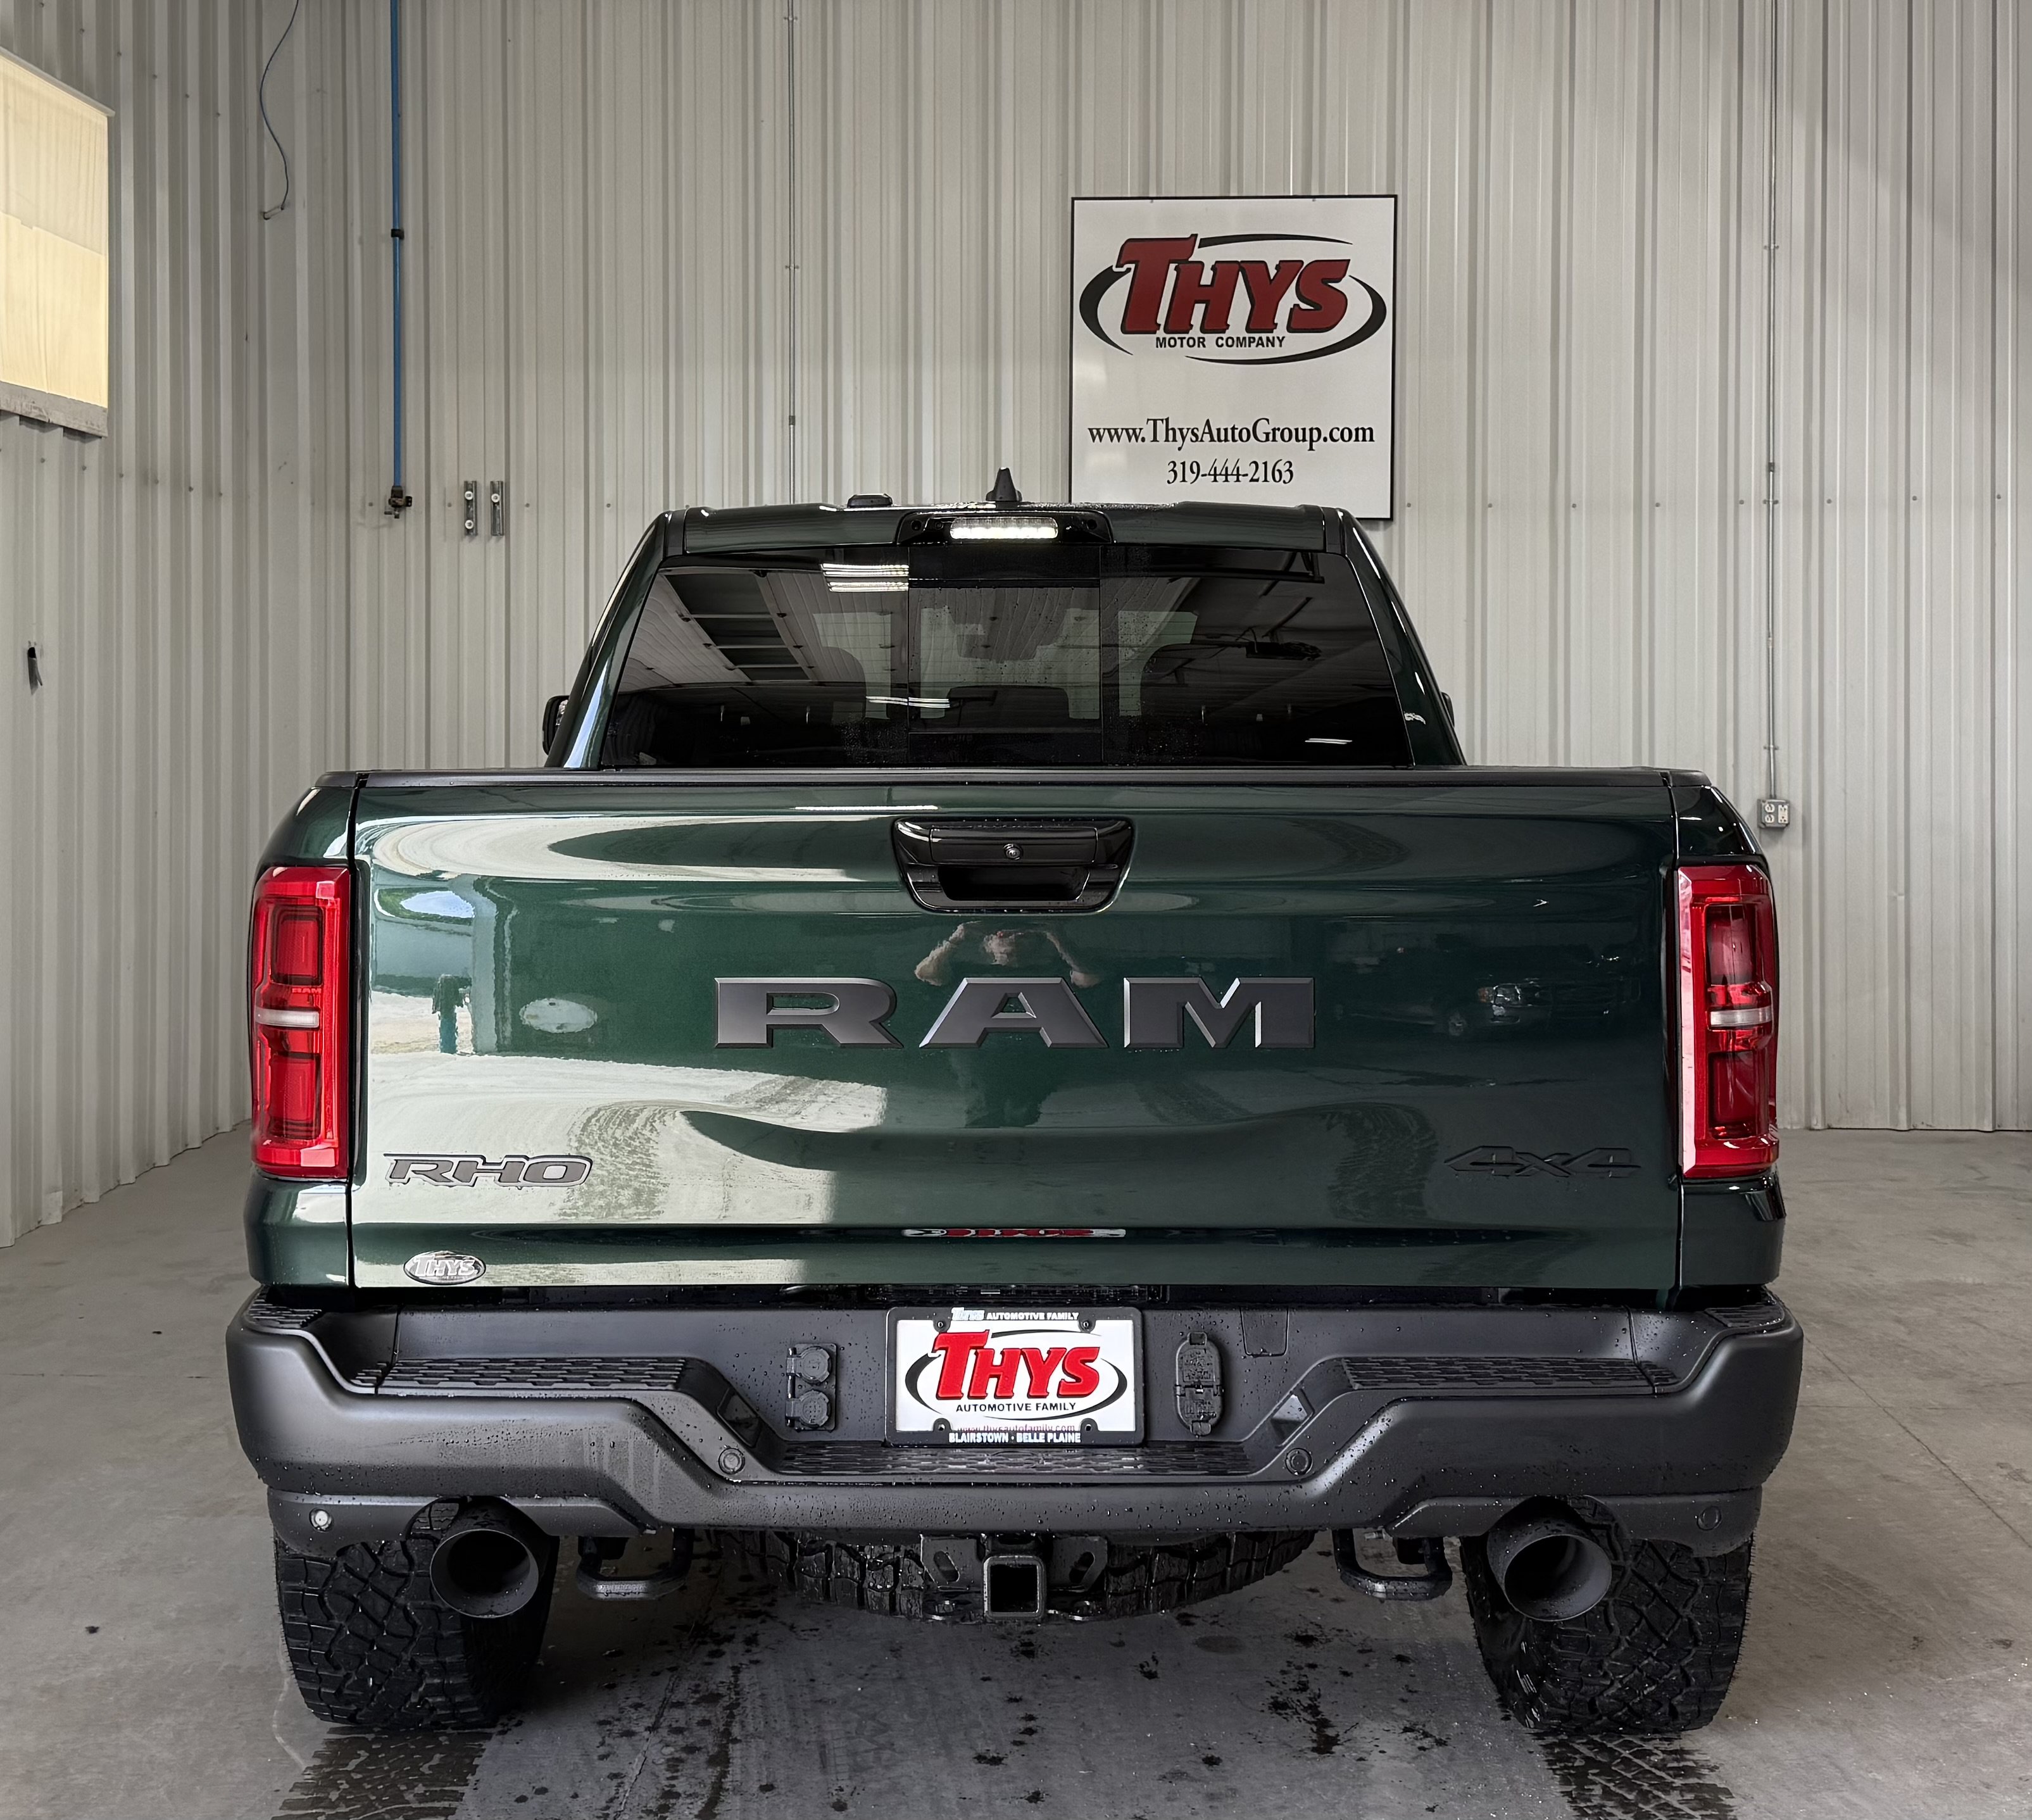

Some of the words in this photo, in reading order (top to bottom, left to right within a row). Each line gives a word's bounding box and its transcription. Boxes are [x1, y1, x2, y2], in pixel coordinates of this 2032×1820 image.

[1115, 233, 1351, 334] THYS
[1155, 336, 1207, 349] MOTOR
[1215, 336, 1286, 348] COMPANY
[1088, 417, 1375, 451] www.ThysAutoGroup.com
[1166, 458, 1295, 485] 319-444-2163
[715, 977, 1315, 1048] RAM
[384, 1154, 593, 1187] RHO
[413, 1255, 476, 1276] THYS
[986, 1312, 1045, 1321] AUTOMOTIVE
[1046, 1312, 1079, 1321] FAMILY
[932, 1329, 1100, 1401] THYS
[956, 1403, 1032, 1412] AUTOMOTIVE
[1036, 1402, 1076, 1411] FAMILY
[949, 1432, 1009, 1443] BLAIRSTOWN
[1016, 1432, 1045, 1443] BELLE
[1046, 1432, 1081, 1443] PLAINE
